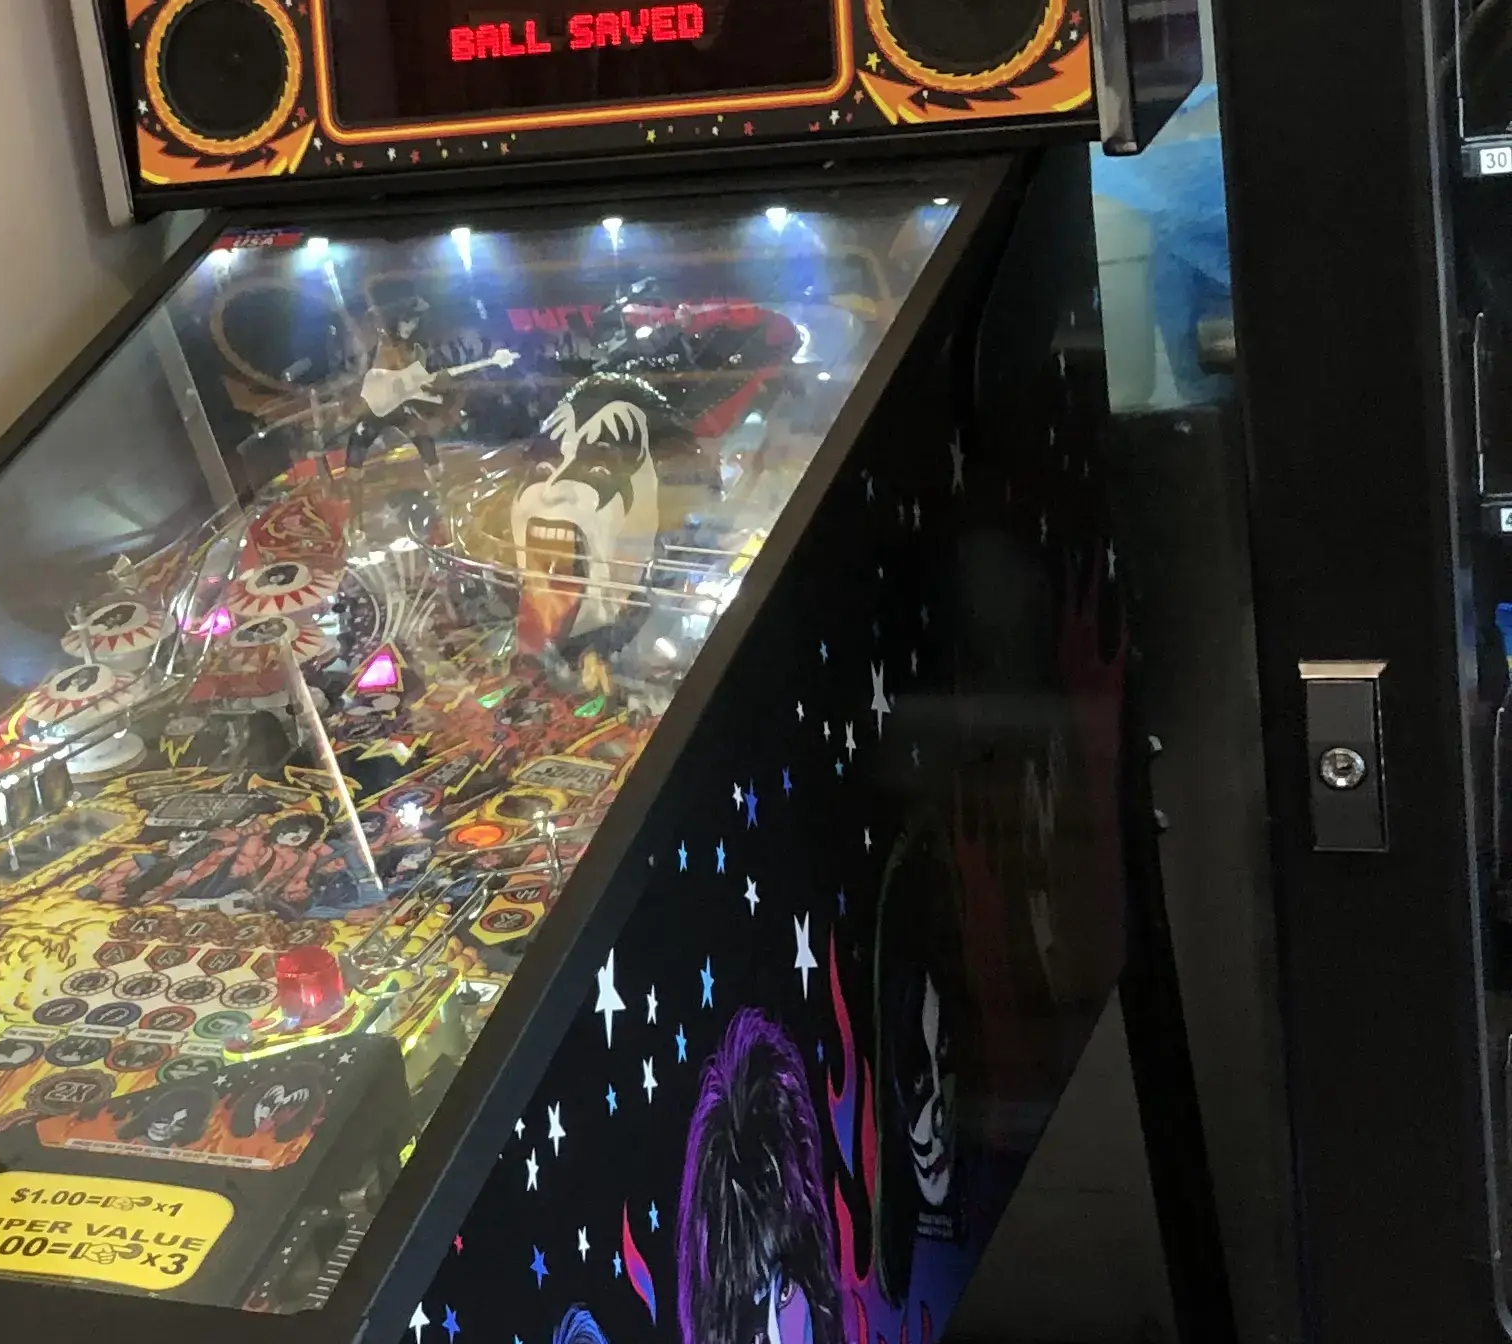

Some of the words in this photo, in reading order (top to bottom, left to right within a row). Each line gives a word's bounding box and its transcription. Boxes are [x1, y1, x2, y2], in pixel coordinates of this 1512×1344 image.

[449, 20, 552, 62] BALL
[569, 3, 704, 50] SAVED
[1486, 151, 1508, 169] 30
[85, 1222, 207, 1253] VALUE
